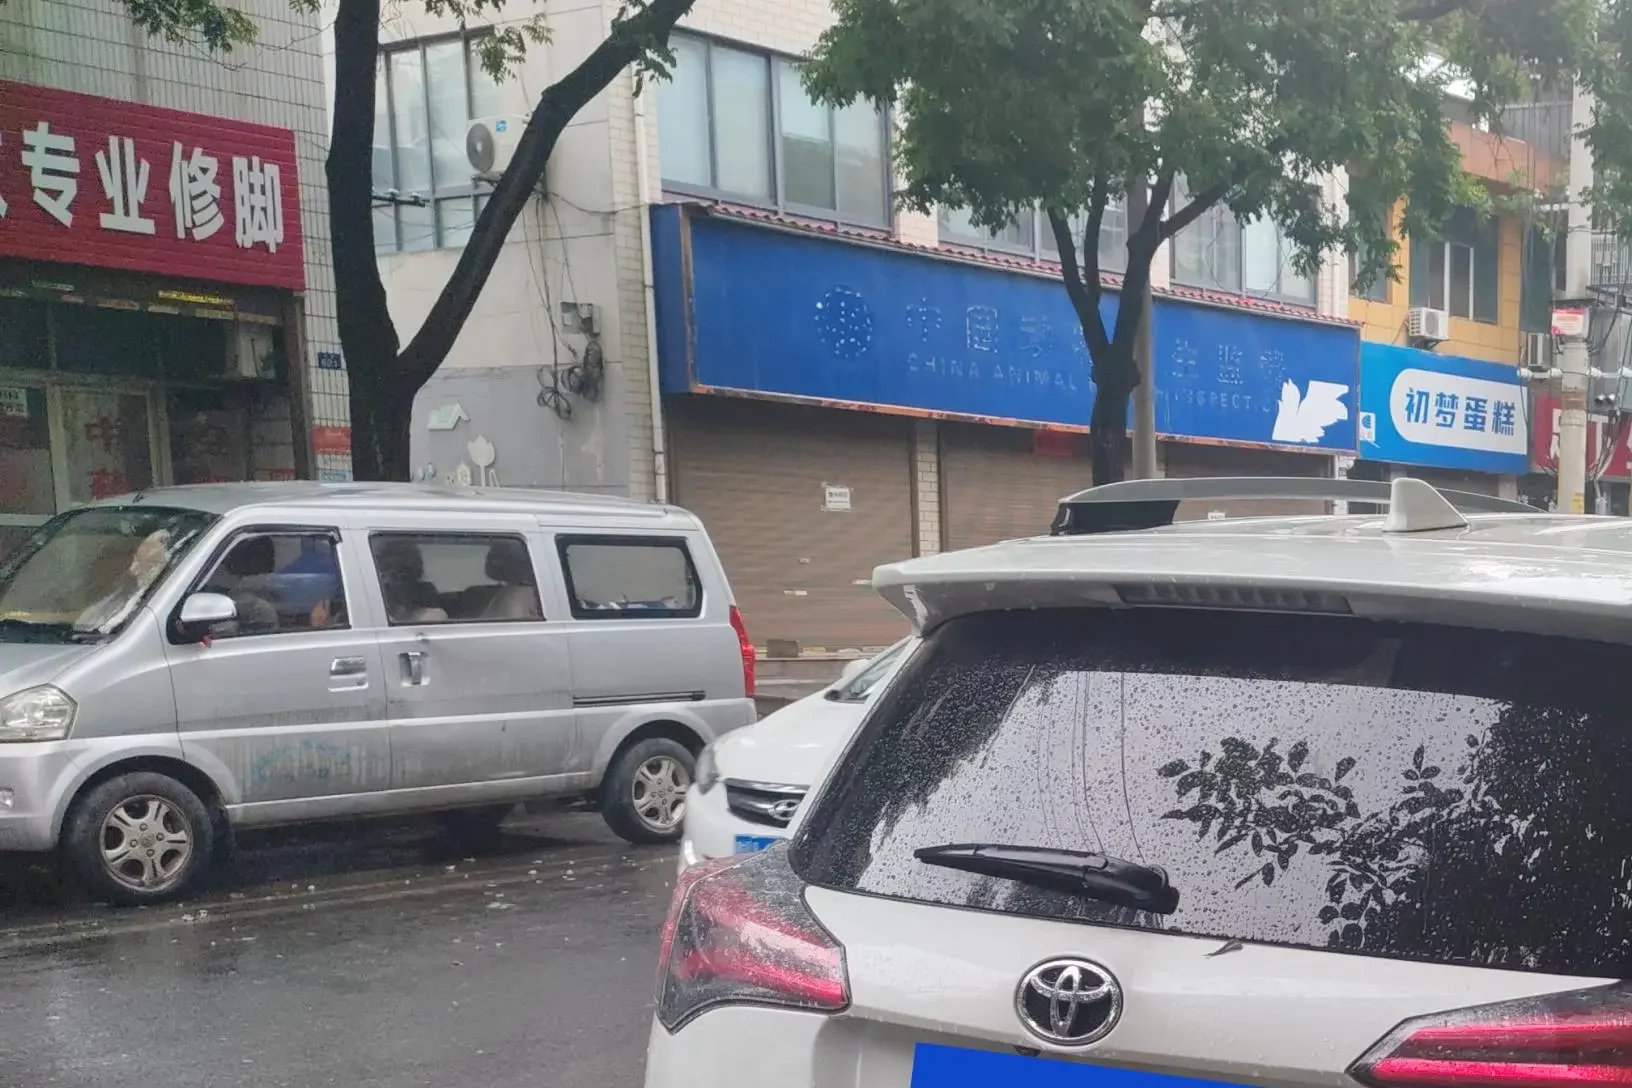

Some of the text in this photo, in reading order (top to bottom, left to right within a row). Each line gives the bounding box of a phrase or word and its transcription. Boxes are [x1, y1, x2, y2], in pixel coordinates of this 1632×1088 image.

[0, 121, 284, 254] 专业修脚
[1404, 387, 1516, 437] 初梦蛋糕
